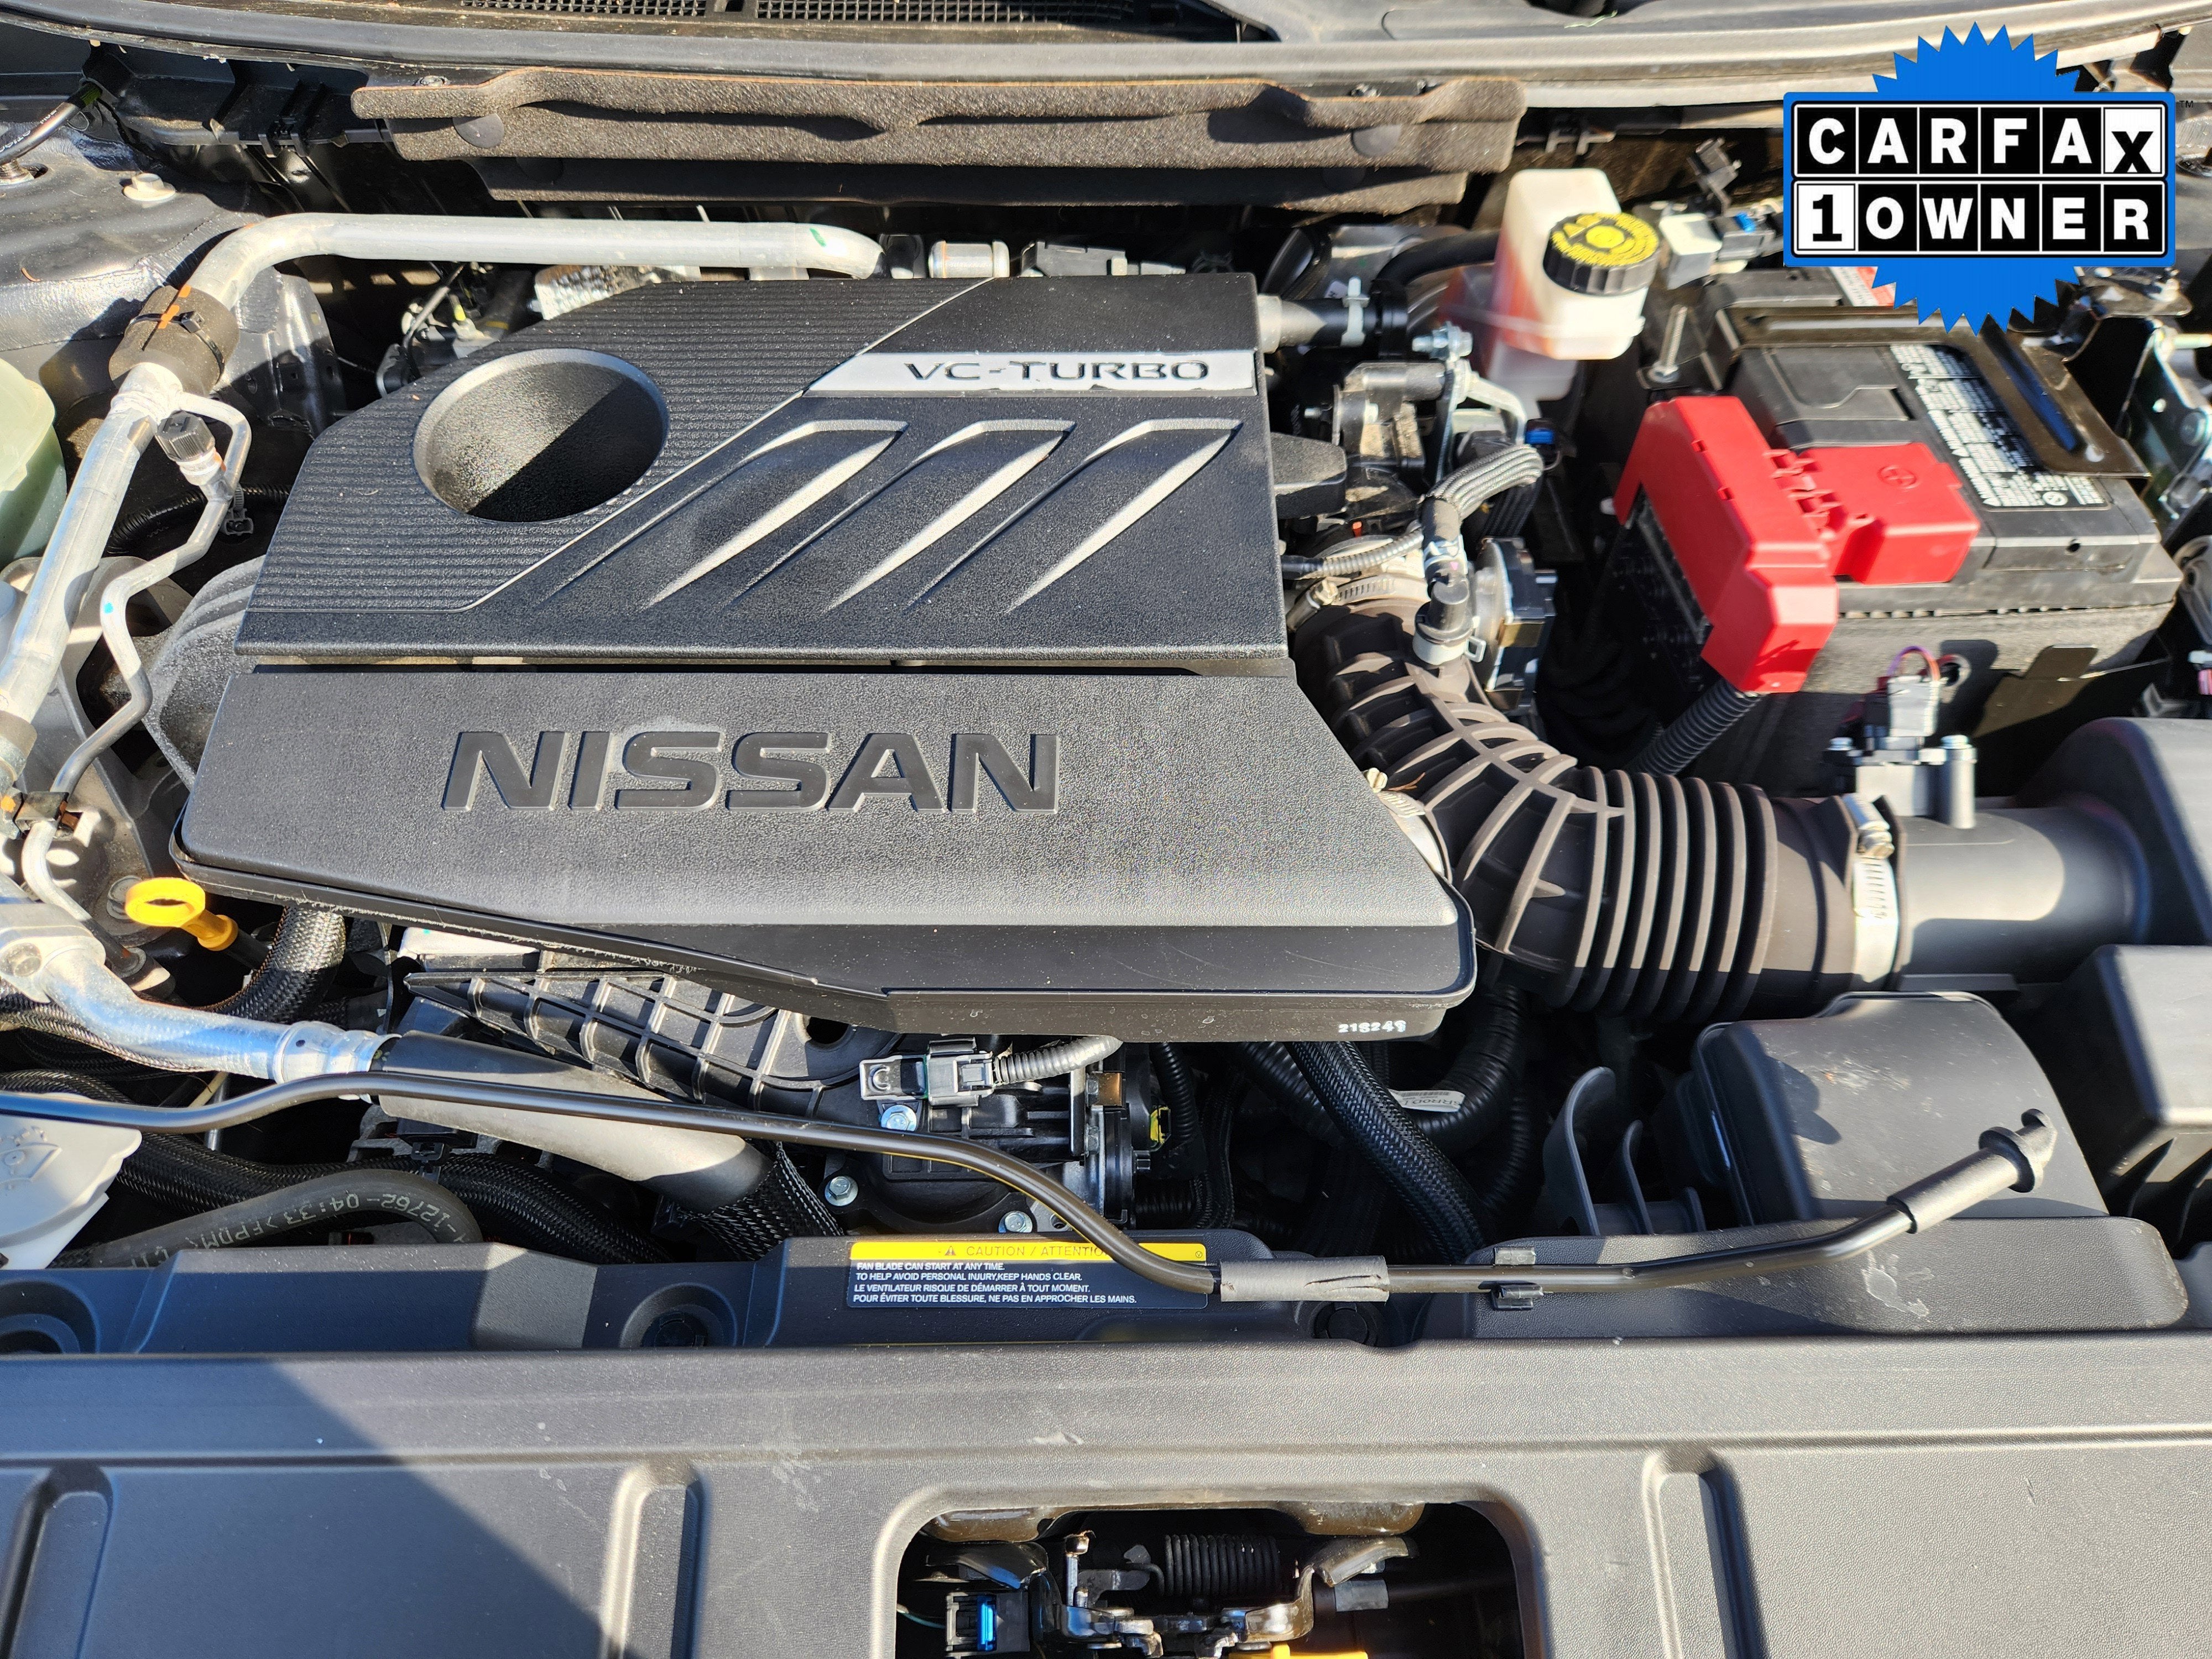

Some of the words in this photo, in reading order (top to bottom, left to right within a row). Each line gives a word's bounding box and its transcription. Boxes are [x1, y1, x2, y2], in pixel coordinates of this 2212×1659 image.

[904, 361, 1209, 380] VC-TURBO
[442, 731, 1060, 814] NISSAN
[966, 1246, 1025, 1256] CAUTION
[1041, 1246, 1108, 1256] ATTENTIO
[857, 1262, 874, 1270] FAN
[874, 1262, 904, 1270] BLADE
[904, 1262, 924, 1270] CAN
[924, 1262, 952, 1270] START
[952, 1262, 964, 1270] AT
[964, 1262, 983, 1270] ANY
[983, 1262, 1005, 1270] TIME.
[855, 1272, 868, 1281] TO
[869, 1272, 892, 1281] HELP
[893, 1272, 920, 1281] AVOID
[921, 1272, 967, 1281] PERSONAL
[1021, 1272, 1051, 1281] HANDS
[1052, 1272, 1083, 1281] CLEAR.
[854, 1284, 865, 1292] LE
[867, 1284, 922, 1292] VENTILATEUR
[923, 1284, 956, 1292] RISQUE
[957, 1284, 969, 1292] DE
[971, 1282, 1018, 1292] DÉMARRER
[1019, 1282, 1026, 1292] À
[1027, 1284, 1050, 1292] TOUT
[1051, 1284, 1091, 1293] MOMENT.
[853, 1294, 879, 1303] POUR
[879, 1292, 909, 1303] ÉVITER
[911, 1294, 938, 1303] TOUTE
[940, 1294, 987, 1303] BLESSURE,
[988, 1294, 1001, 1303] NE
[1002, 1294, 1019, 1303] PAS
[1021, 1294, 1033, 1303] EN
[1034, 1294, 1088, 1303] APPROCHER
[1089, 1294, 1106, 1303] LES
[1108, 1295, 1137, 1303] MAINS.
